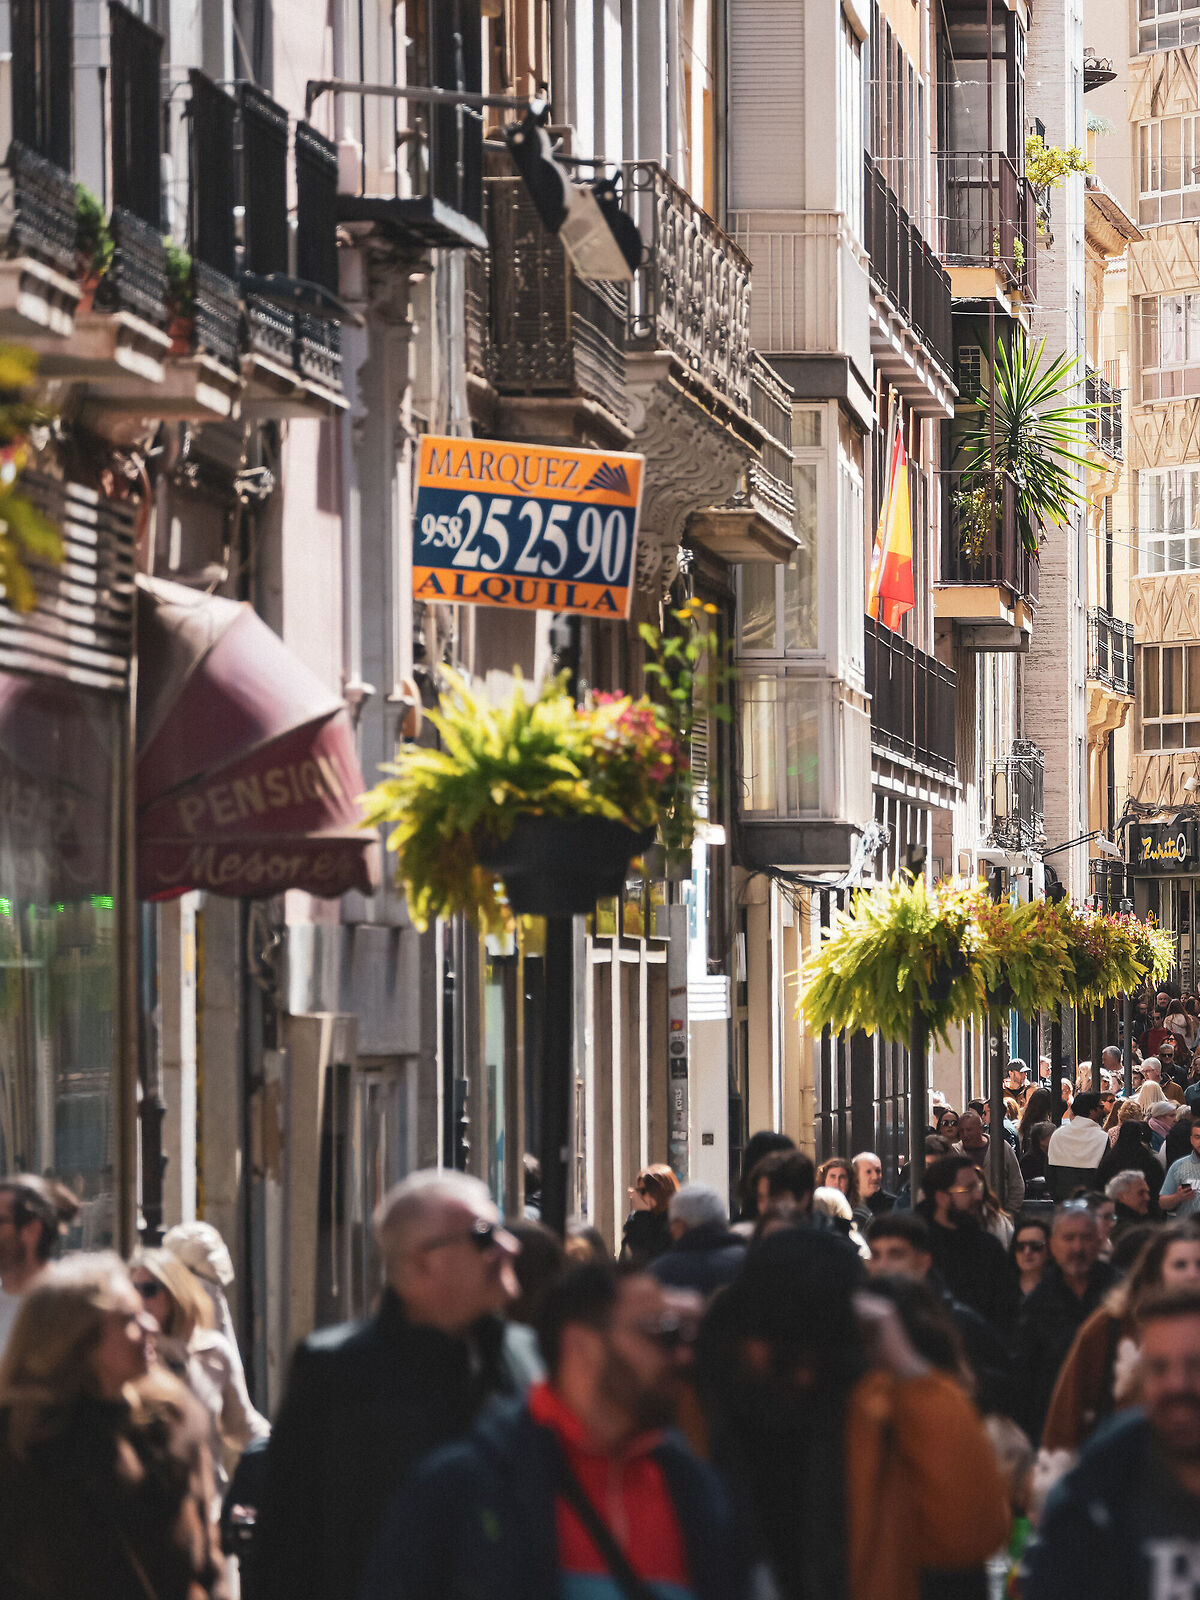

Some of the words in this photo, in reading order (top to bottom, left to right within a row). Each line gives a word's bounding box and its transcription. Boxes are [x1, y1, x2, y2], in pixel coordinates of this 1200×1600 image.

[427, 447, 582, 495] MARQUEZ
[420, 512, 464, 549] 958
[451, 494, 513, 571] 25
[514, 500, 573, 577] 25
[573, 506, 628, 582] 90
[417, 571, 619, 612] ALQUILA
